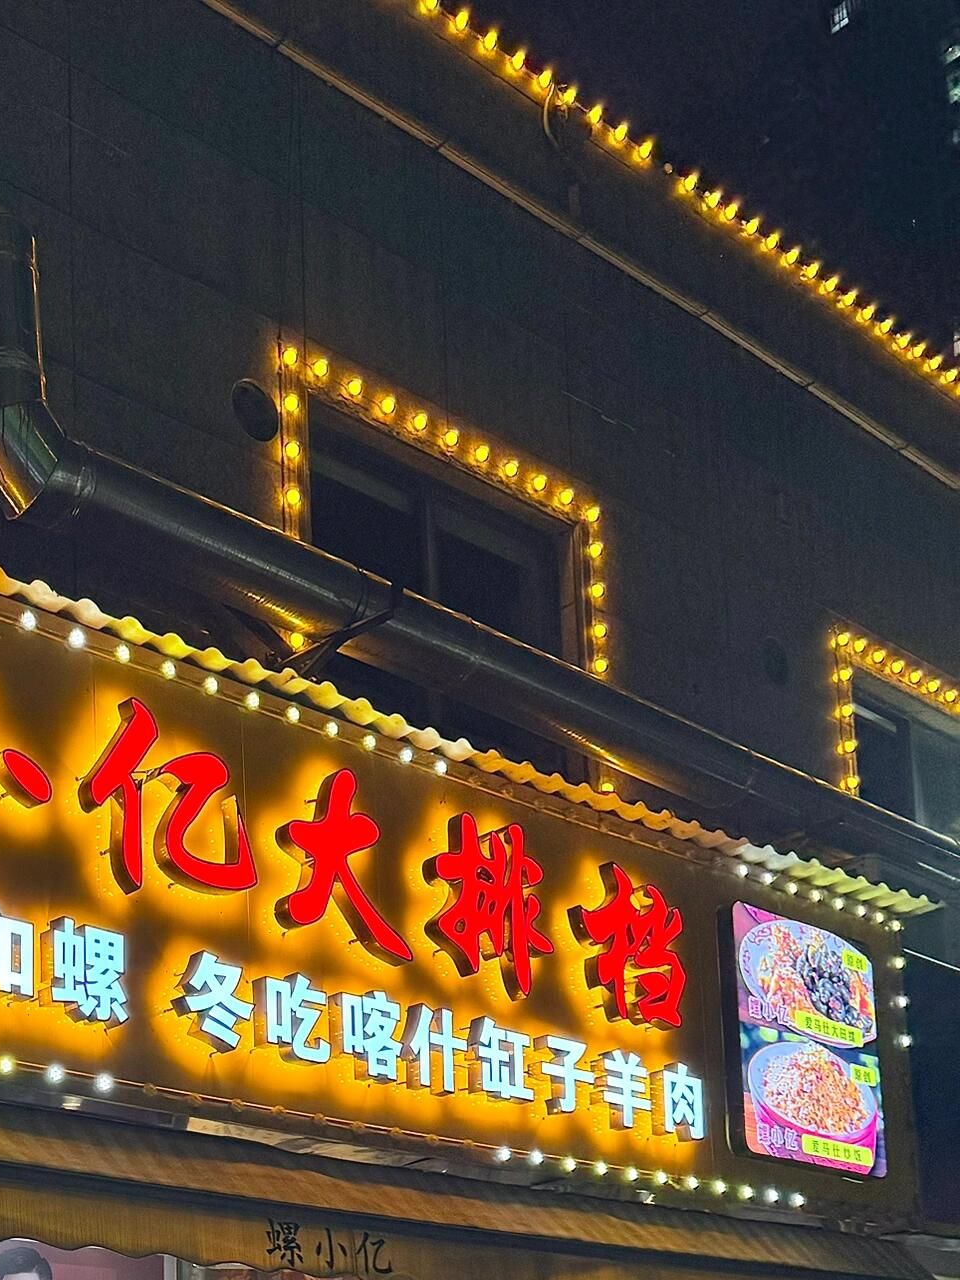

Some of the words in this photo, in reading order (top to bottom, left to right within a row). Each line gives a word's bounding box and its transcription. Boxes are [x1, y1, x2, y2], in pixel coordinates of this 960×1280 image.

[176, 951, 705, 1141] 冬吃喀什缸子羊肉
[265, 1217, 393, 1275] 螺小亿
